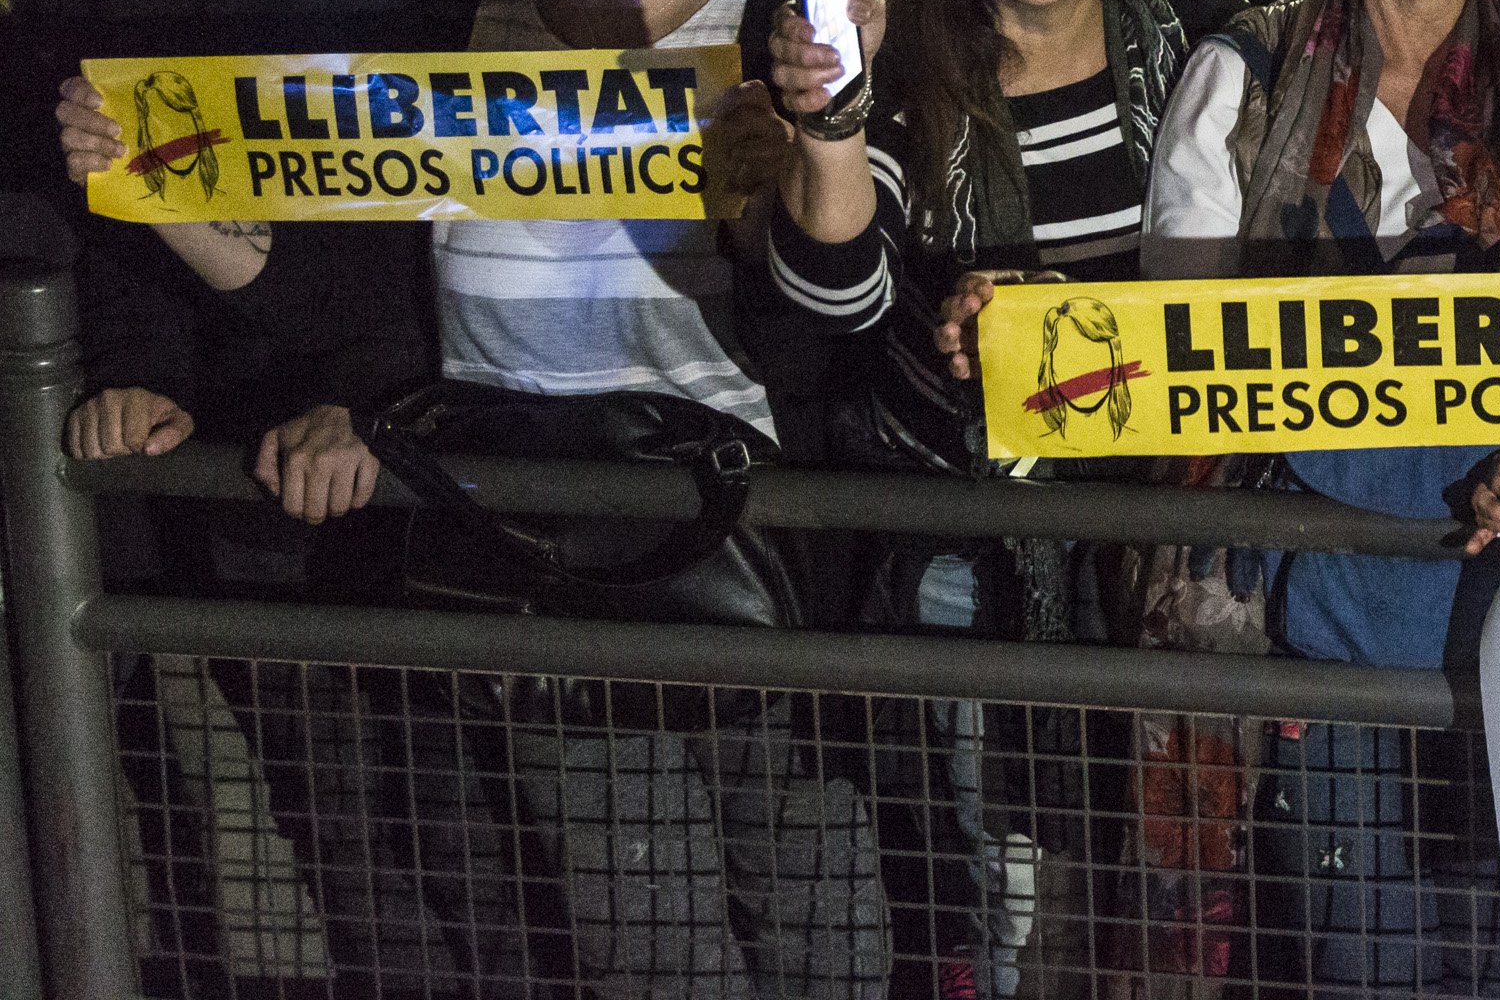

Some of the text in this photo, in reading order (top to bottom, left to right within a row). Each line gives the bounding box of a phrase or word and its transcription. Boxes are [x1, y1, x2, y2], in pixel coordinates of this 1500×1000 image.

[233, 67, 698, 140] LLIBERTAT
[248, 132, 703, 197] PRESOS POLÍTICS
[1168, 379, 1407, 435] PRESOS
